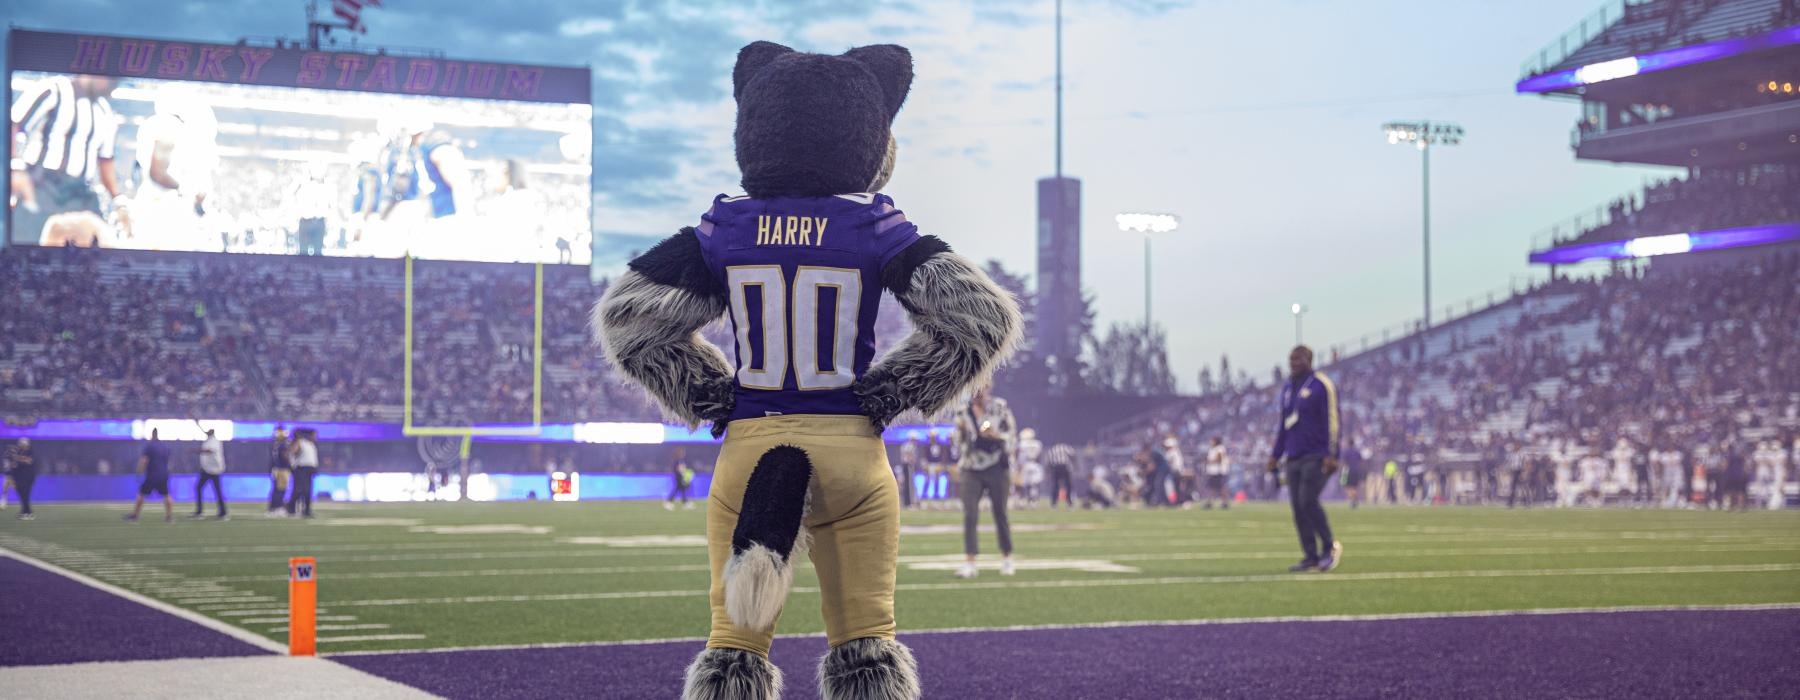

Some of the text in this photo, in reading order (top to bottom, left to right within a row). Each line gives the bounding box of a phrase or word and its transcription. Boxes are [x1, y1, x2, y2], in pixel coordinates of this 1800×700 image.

[70, 36, 543, 98] HUSKY STADIUM
[757, 215, 828, 247] HARRY
[726, 264, 863, 391] 00
[296, 565, 313, 578] W
